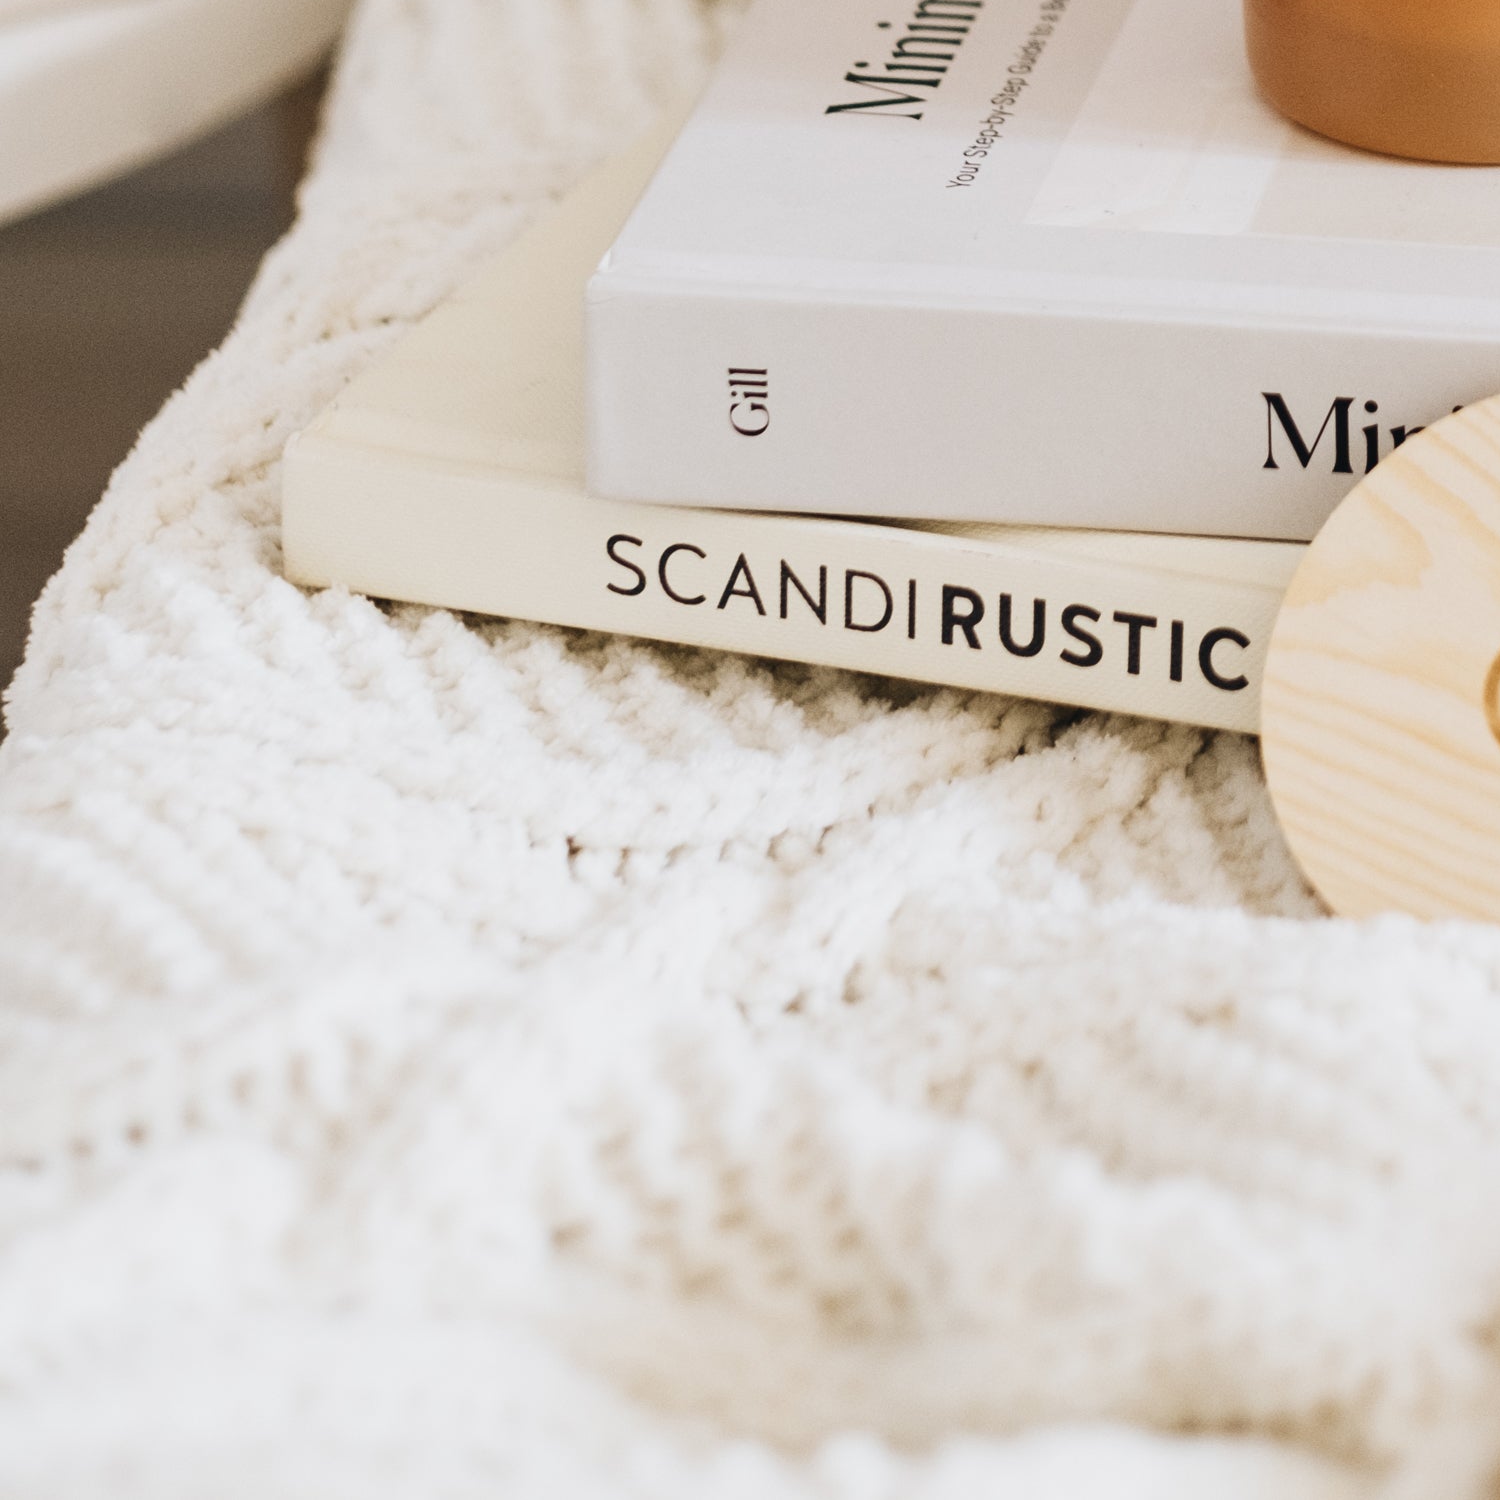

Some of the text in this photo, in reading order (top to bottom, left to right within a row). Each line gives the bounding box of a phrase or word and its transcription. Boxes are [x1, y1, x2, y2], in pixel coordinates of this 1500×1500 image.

[963, 77, 1030, 159] Step-by-Step
[946, 160, 981, 190] Your
[728, 367, 770, 437] Gill
